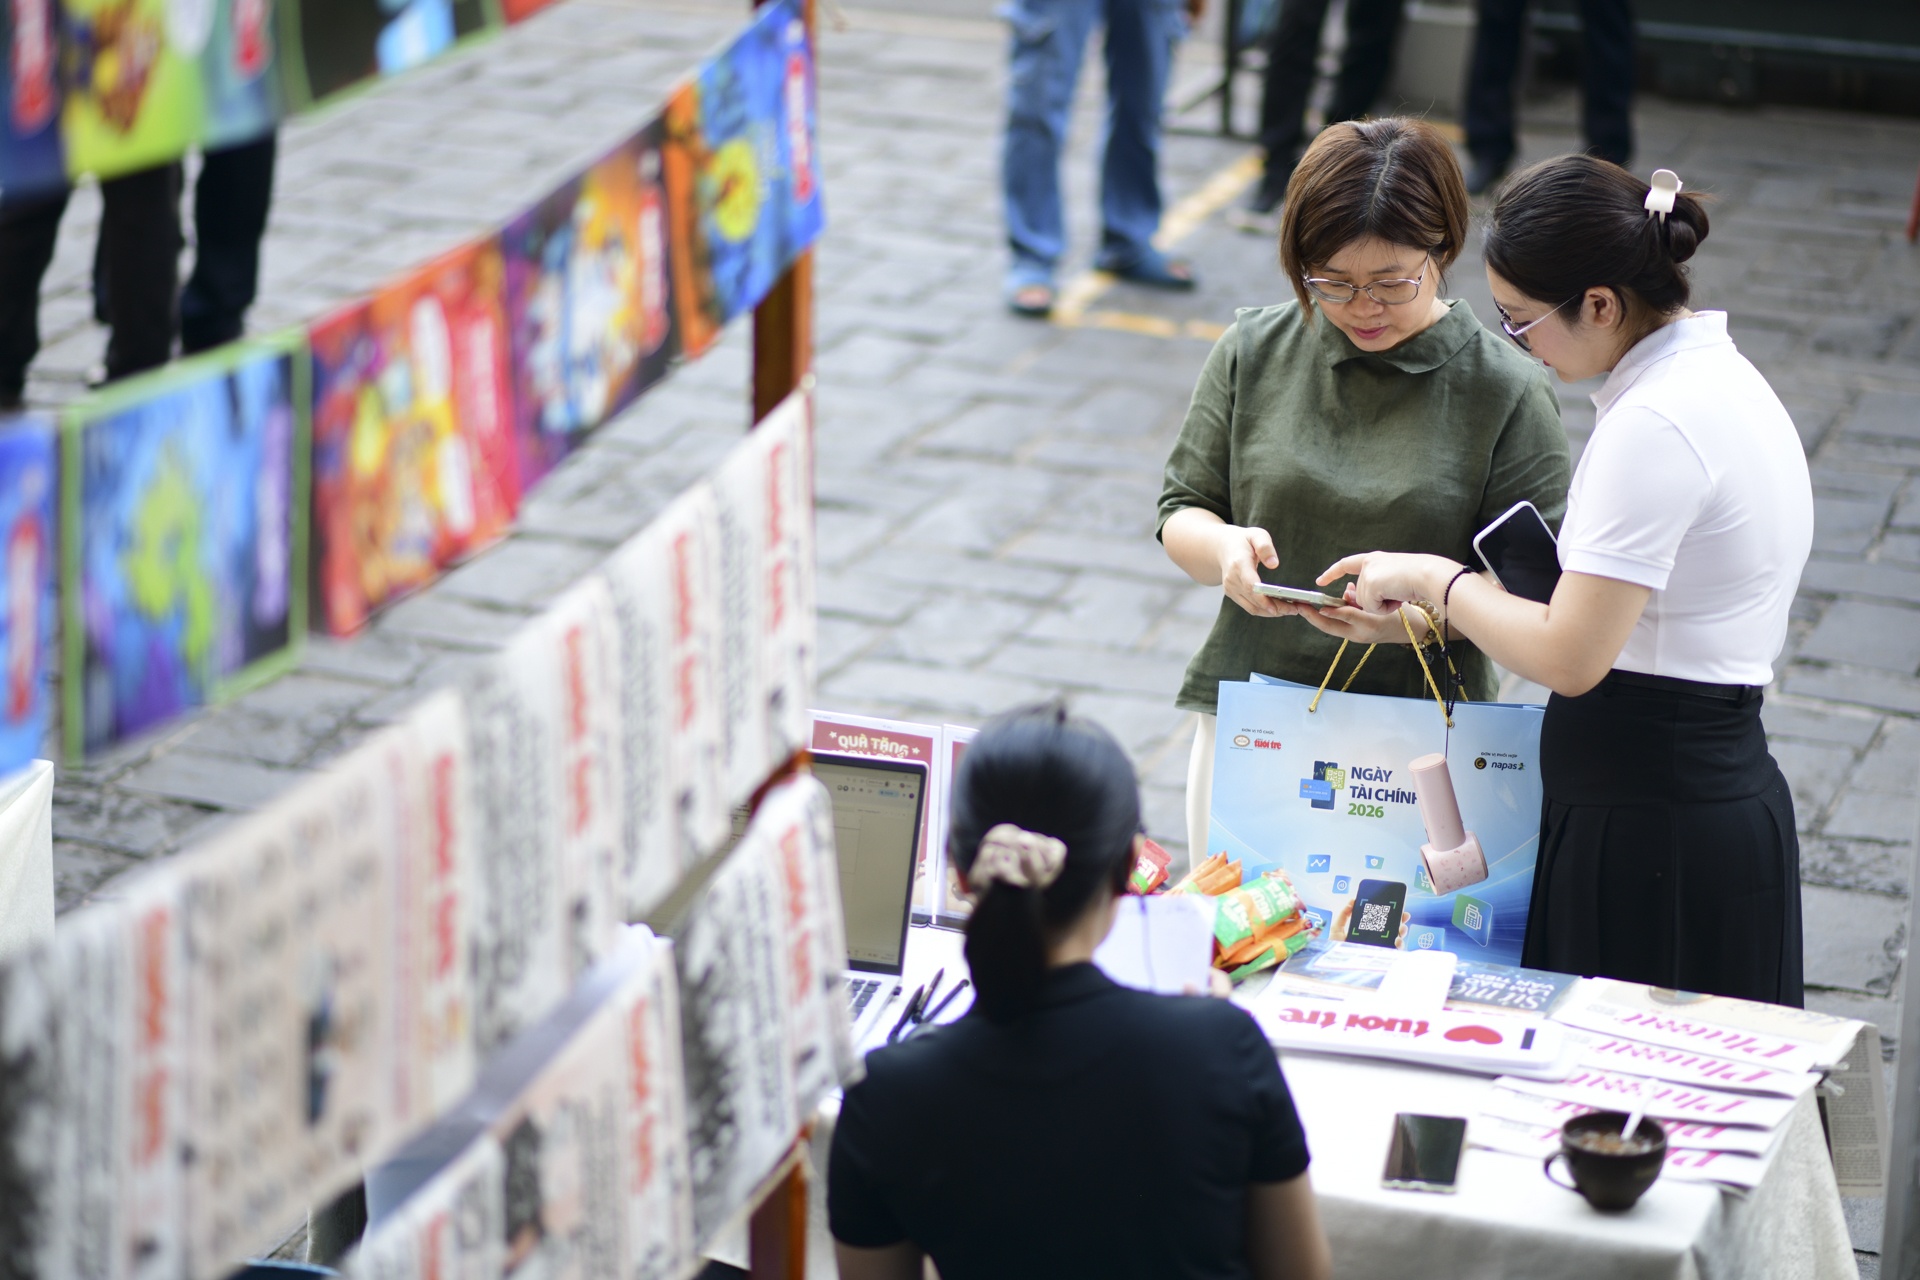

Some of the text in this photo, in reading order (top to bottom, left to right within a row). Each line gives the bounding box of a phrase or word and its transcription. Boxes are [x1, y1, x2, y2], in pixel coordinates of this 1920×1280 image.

[838, 733, 868, 749] QUÀ
[1491, 761, 1518, 771] napas
[1350, 766, 1393, 783] NGÀY
[1349, 783, 1373, 801] TÀI
[1347, 803, 1385, 819] 2026
